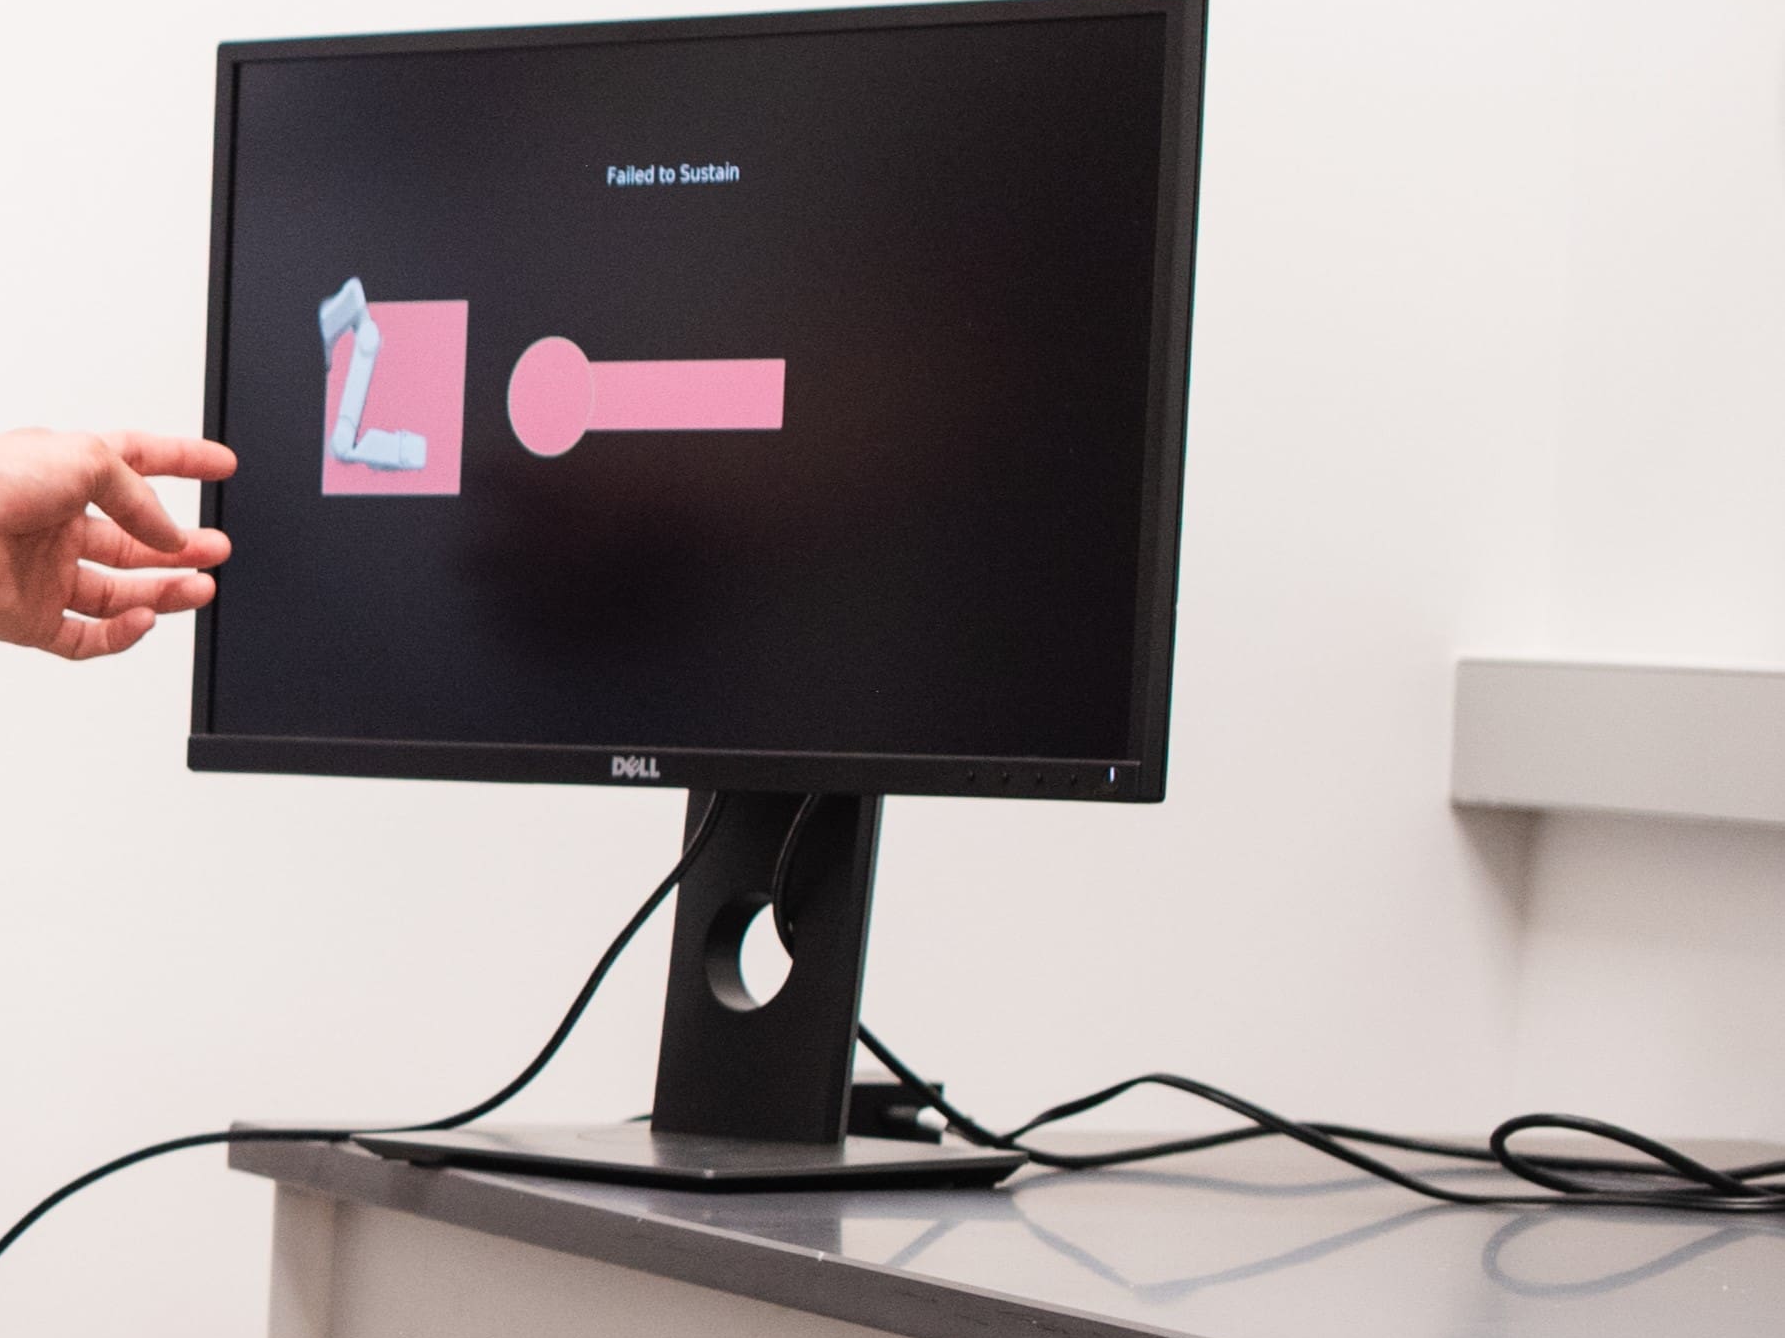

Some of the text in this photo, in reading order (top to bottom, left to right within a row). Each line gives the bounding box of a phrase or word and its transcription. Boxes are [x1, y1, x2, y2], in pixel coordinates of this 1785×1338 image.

[606, 161, 740, 187] Failed to Sustain
[611, 755, 661, 779] DELL
